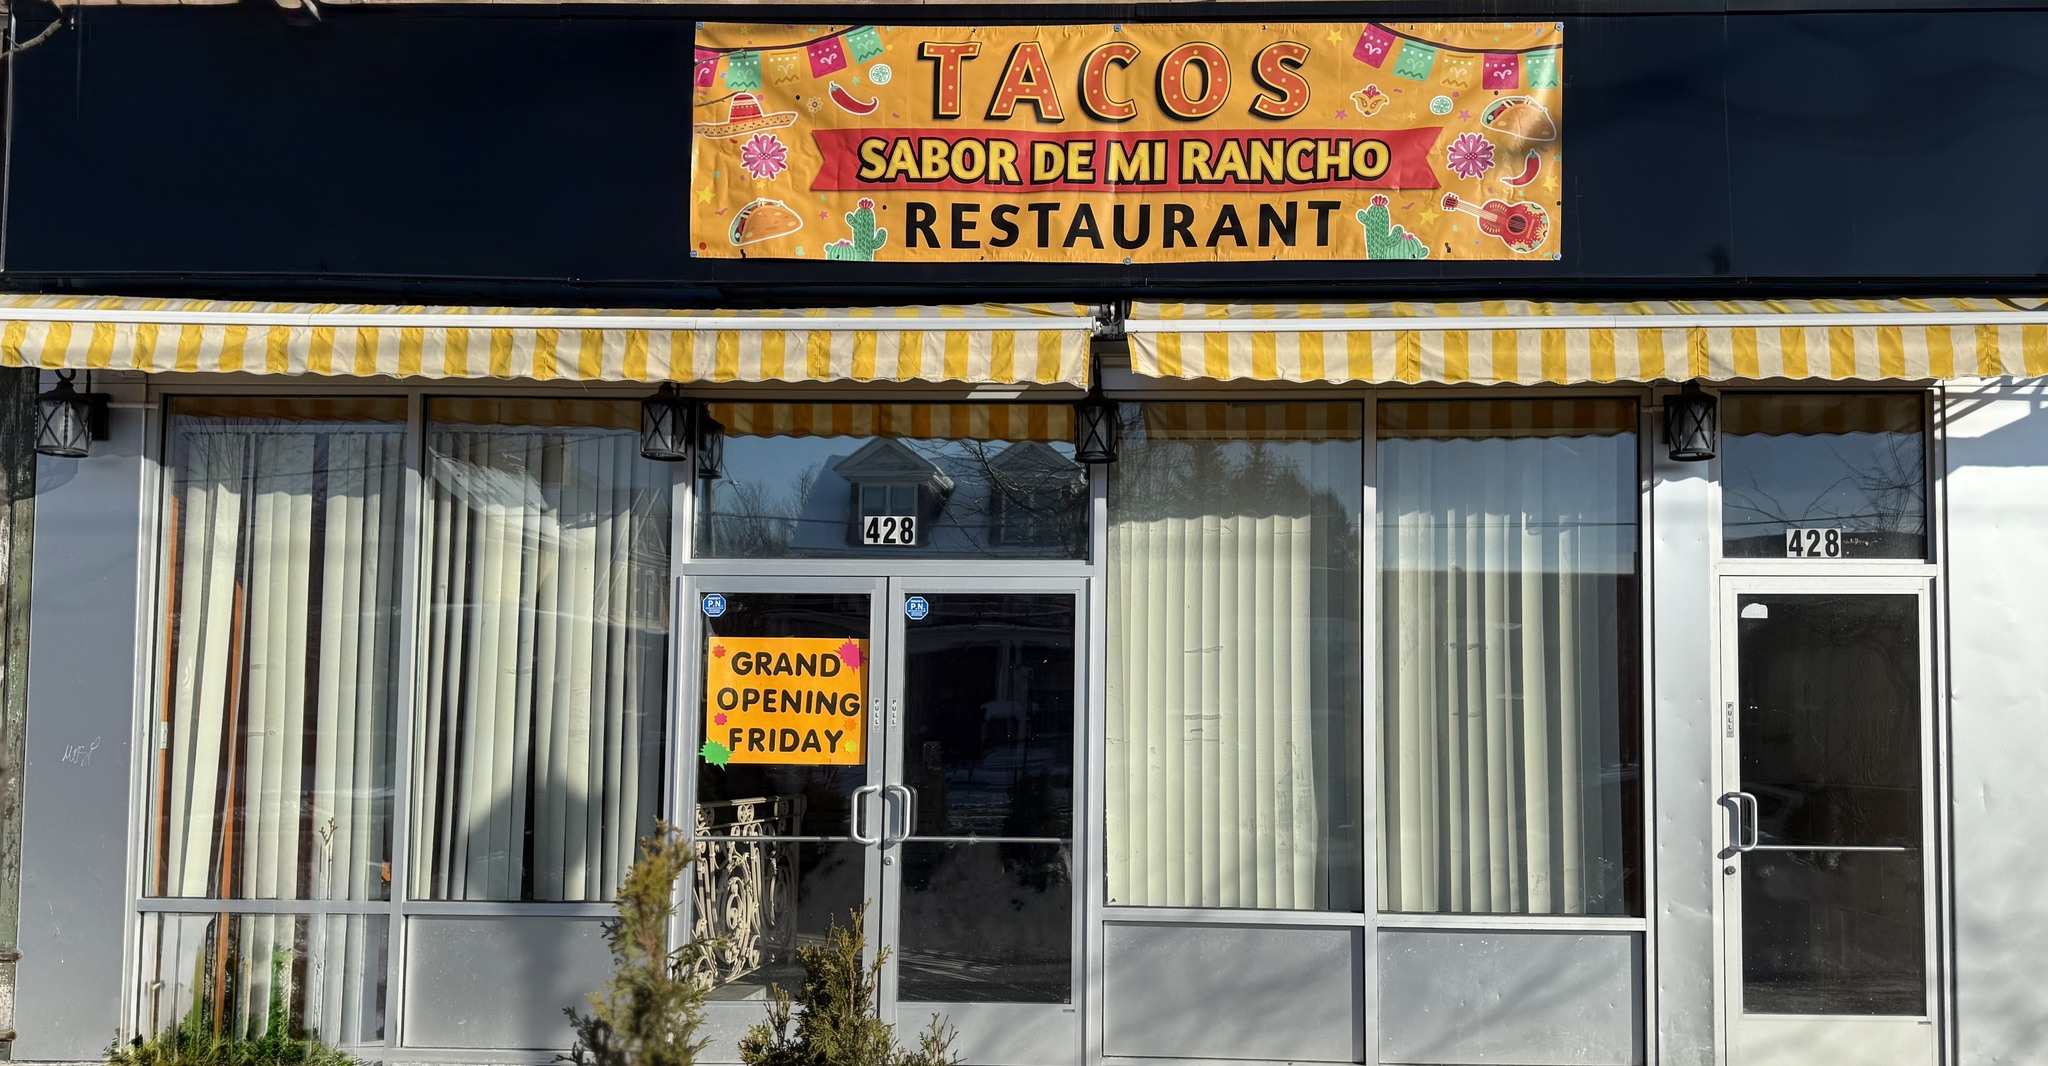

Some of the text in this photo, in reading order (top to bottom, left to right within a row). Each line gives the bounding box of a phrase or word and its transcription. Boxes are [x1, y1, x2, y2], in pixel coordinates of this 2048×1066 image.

[918, 41, 1311, 123] TACOS
[856, 137, 1391, 185] SABOR DE MI RANCHO
[905, 201, 1341, 249] RESTAURANT
[865, 516, 914, 545] 428
[1788, 529, 1840, 557] 428
[731, 651, 841, 678] GRAND
[717, 687, 861, 716] OPENING
[729, 727, 844, 753] FRIDAY
